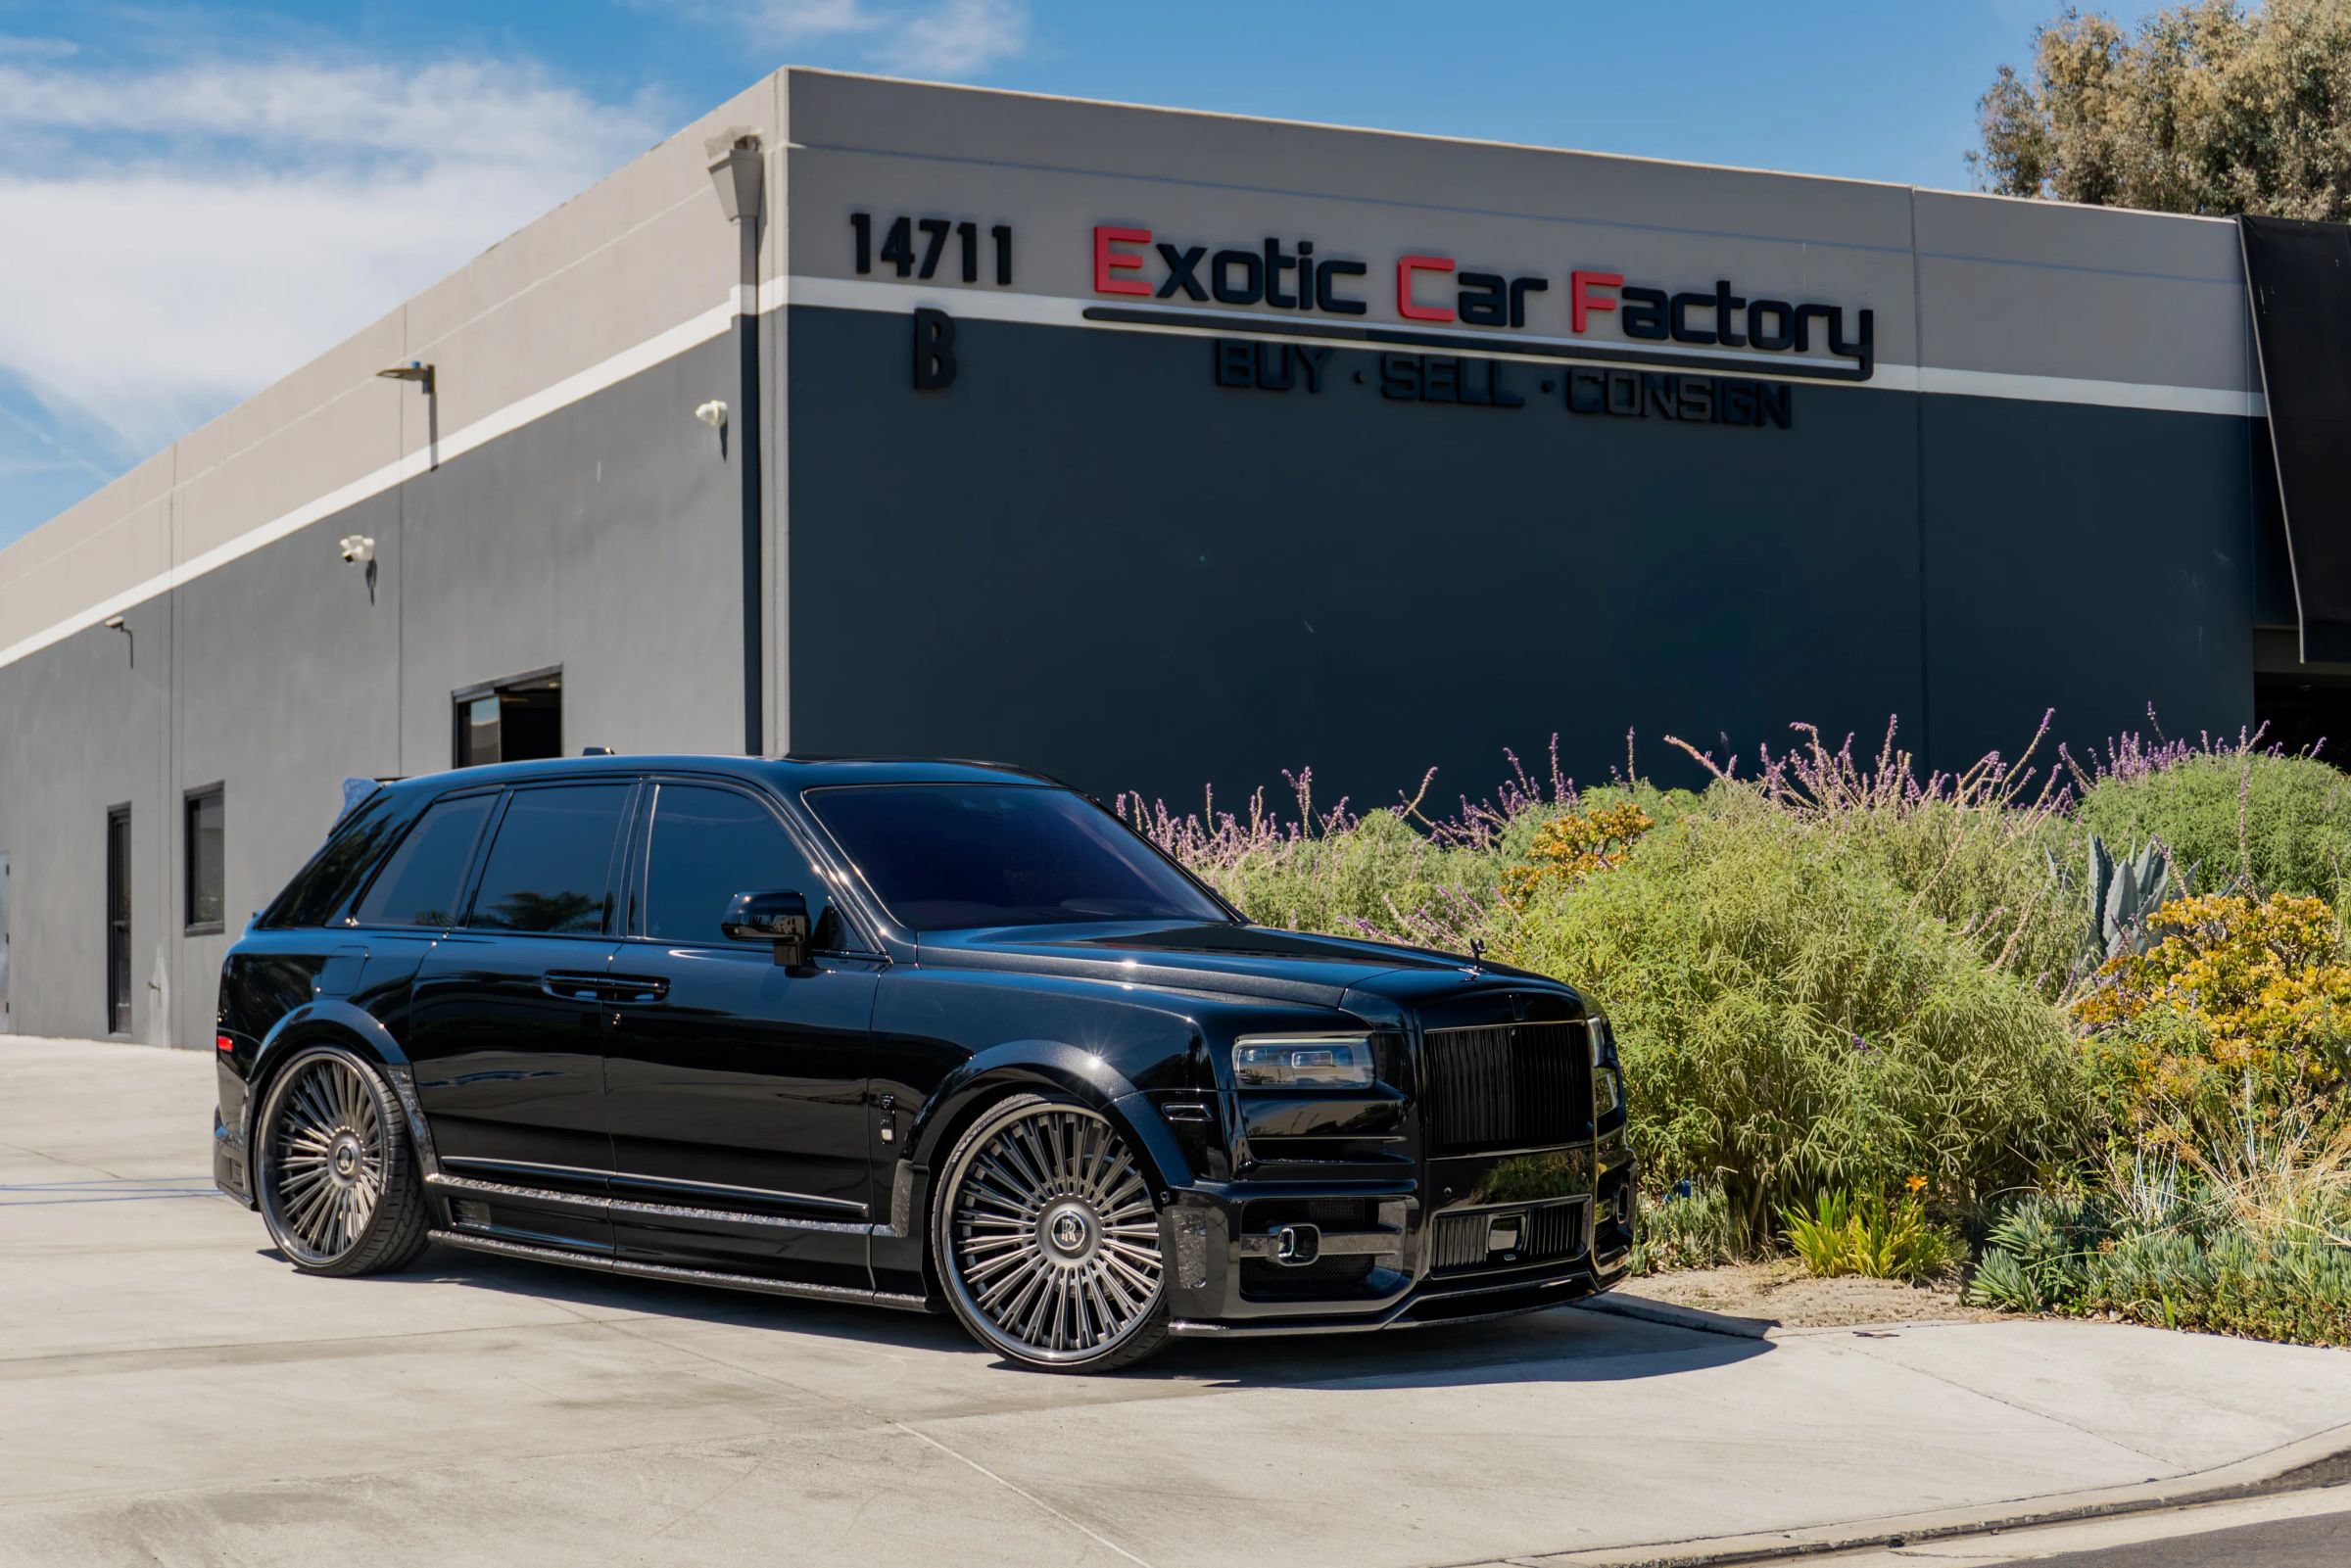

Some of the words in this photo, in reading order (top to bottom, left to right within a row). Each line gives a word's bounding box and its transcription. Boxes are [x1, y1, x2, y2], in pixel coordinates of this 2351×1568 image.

[850, 213, 1012, 285] 14711
[1093, 226, 1367, 314] Exotic
[1397, 256, 1549, 327] Car
[1571, 270, 1873, 381] Factory
[913, 308, 958, 390] B
[1215, 338, 1332, 393] BUY
[1381, 354, 1525, 408] SELL
[1566, 369, 1792, 429] CONSIGN
